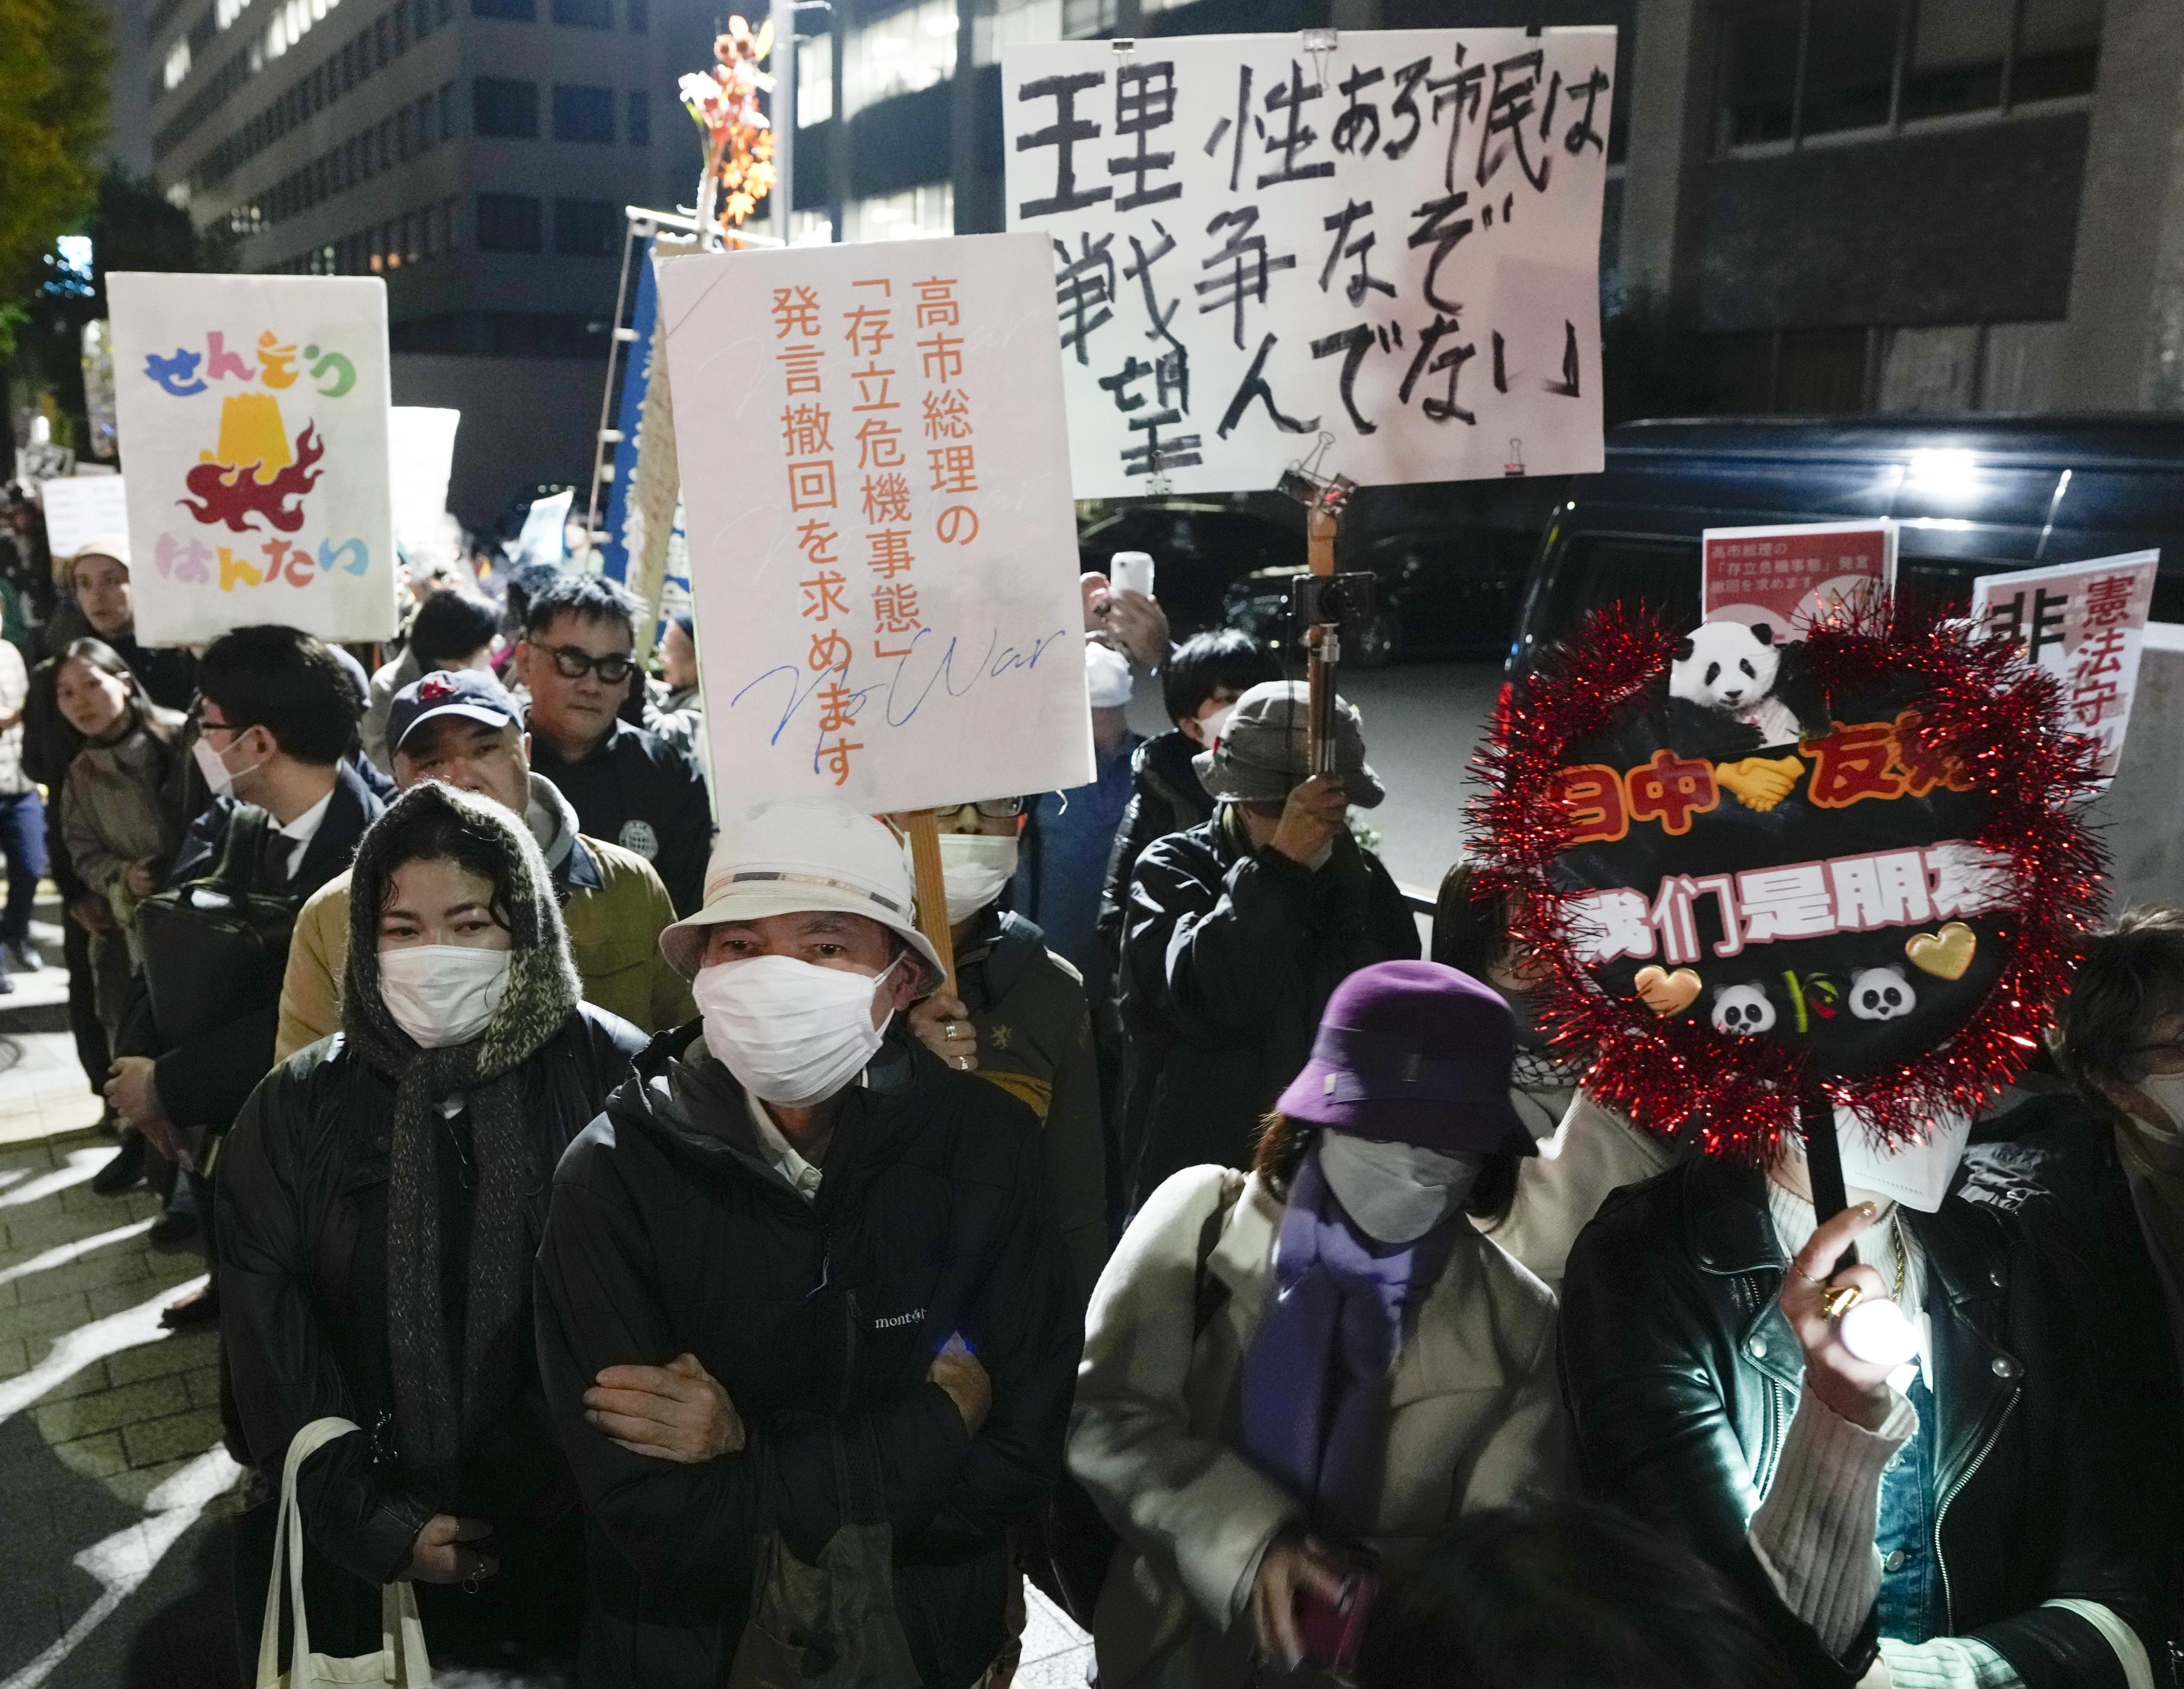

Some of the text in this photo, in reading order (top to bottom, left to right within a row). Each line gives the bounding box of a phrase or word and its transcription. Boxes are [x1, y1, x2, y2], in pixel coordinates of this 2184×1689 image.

[1016, 43, 1610, 218] 理性ある市民は
[143, 329, 357, 398] せんそう
[911, 275, 979, 547] 高市総理の
[771, 285, 864, 786] 発言撤回を求めます
[843, 277, 923, 660] 「存立危機事態」
[155, 532, 369, 593] はんたい
[1544, 748, 1721, 844] 日中
